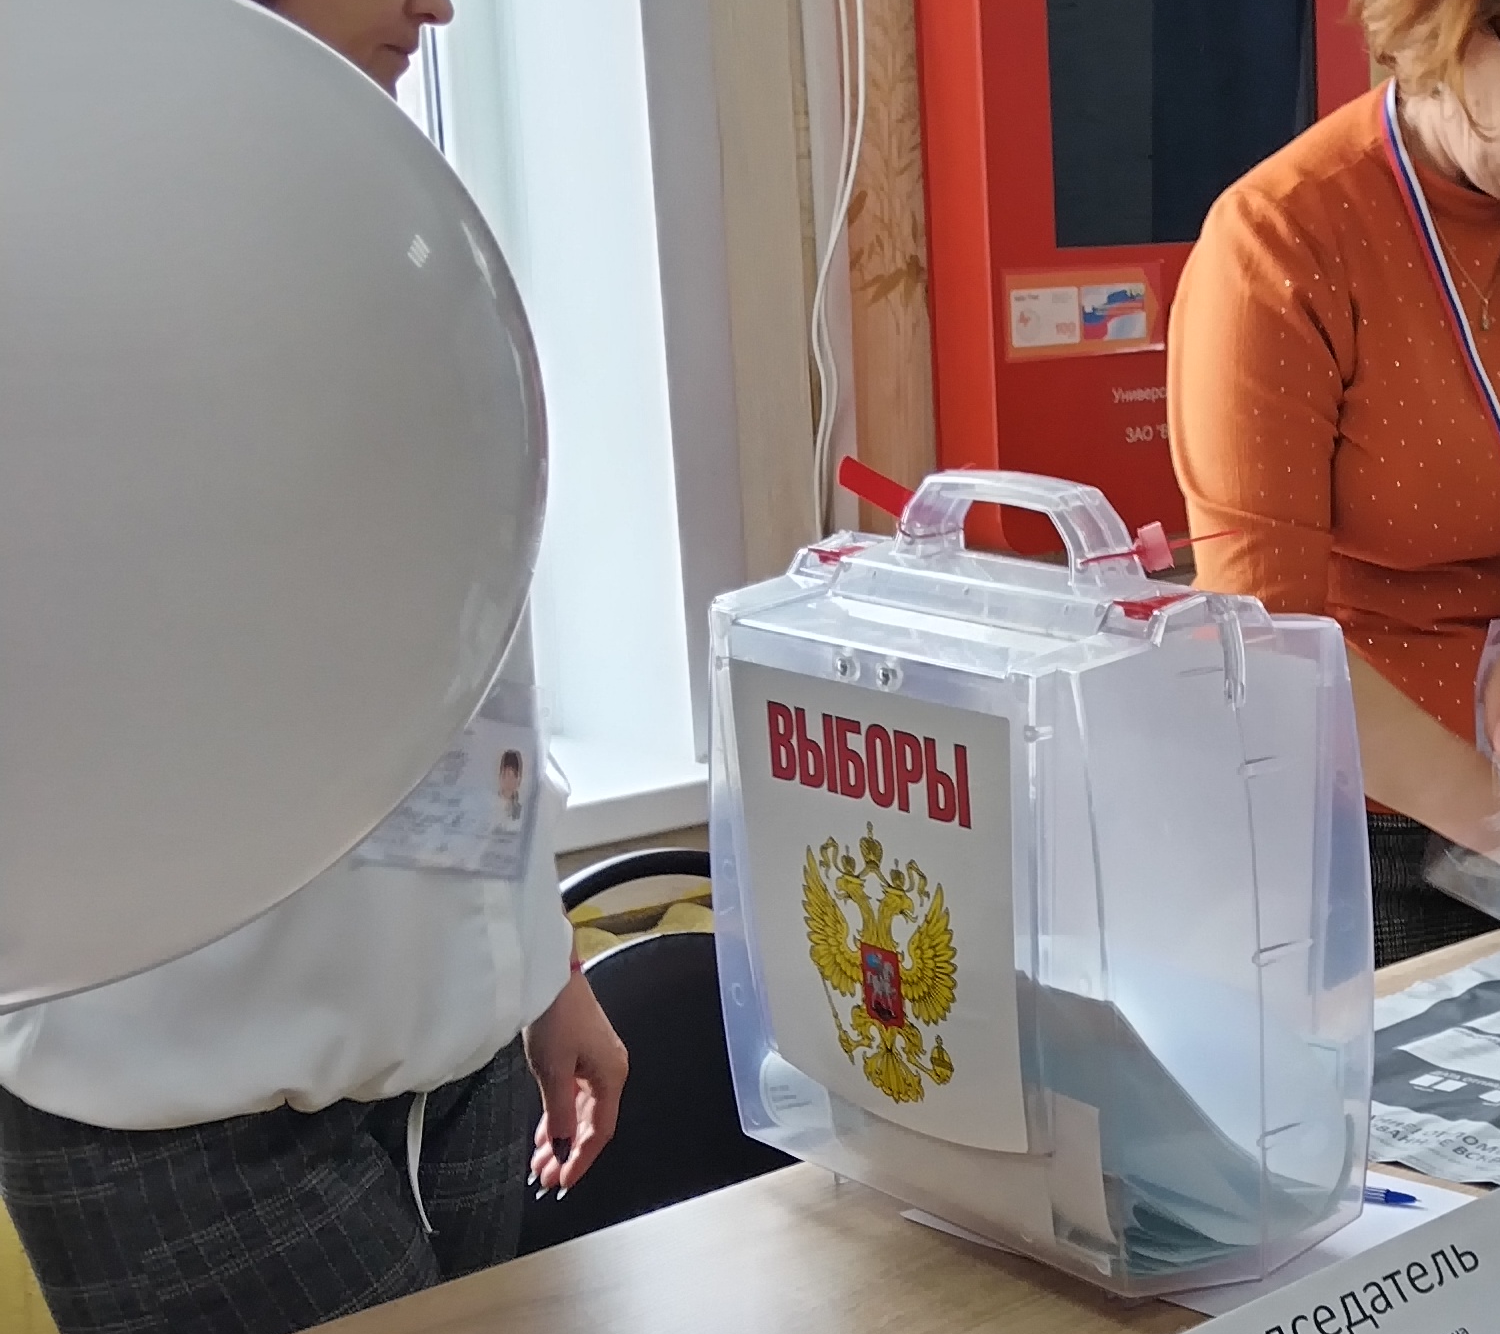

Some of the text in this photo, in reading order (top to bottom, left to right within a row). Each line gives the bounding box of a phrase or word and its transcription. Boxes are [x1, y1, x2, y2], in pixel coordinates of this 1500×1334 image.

[1112, 386, 1167, 403] Универс
[1125, 425, 1153, 444] ЗАО
[766, 699, 972, 830] ВЫБОРЫ
